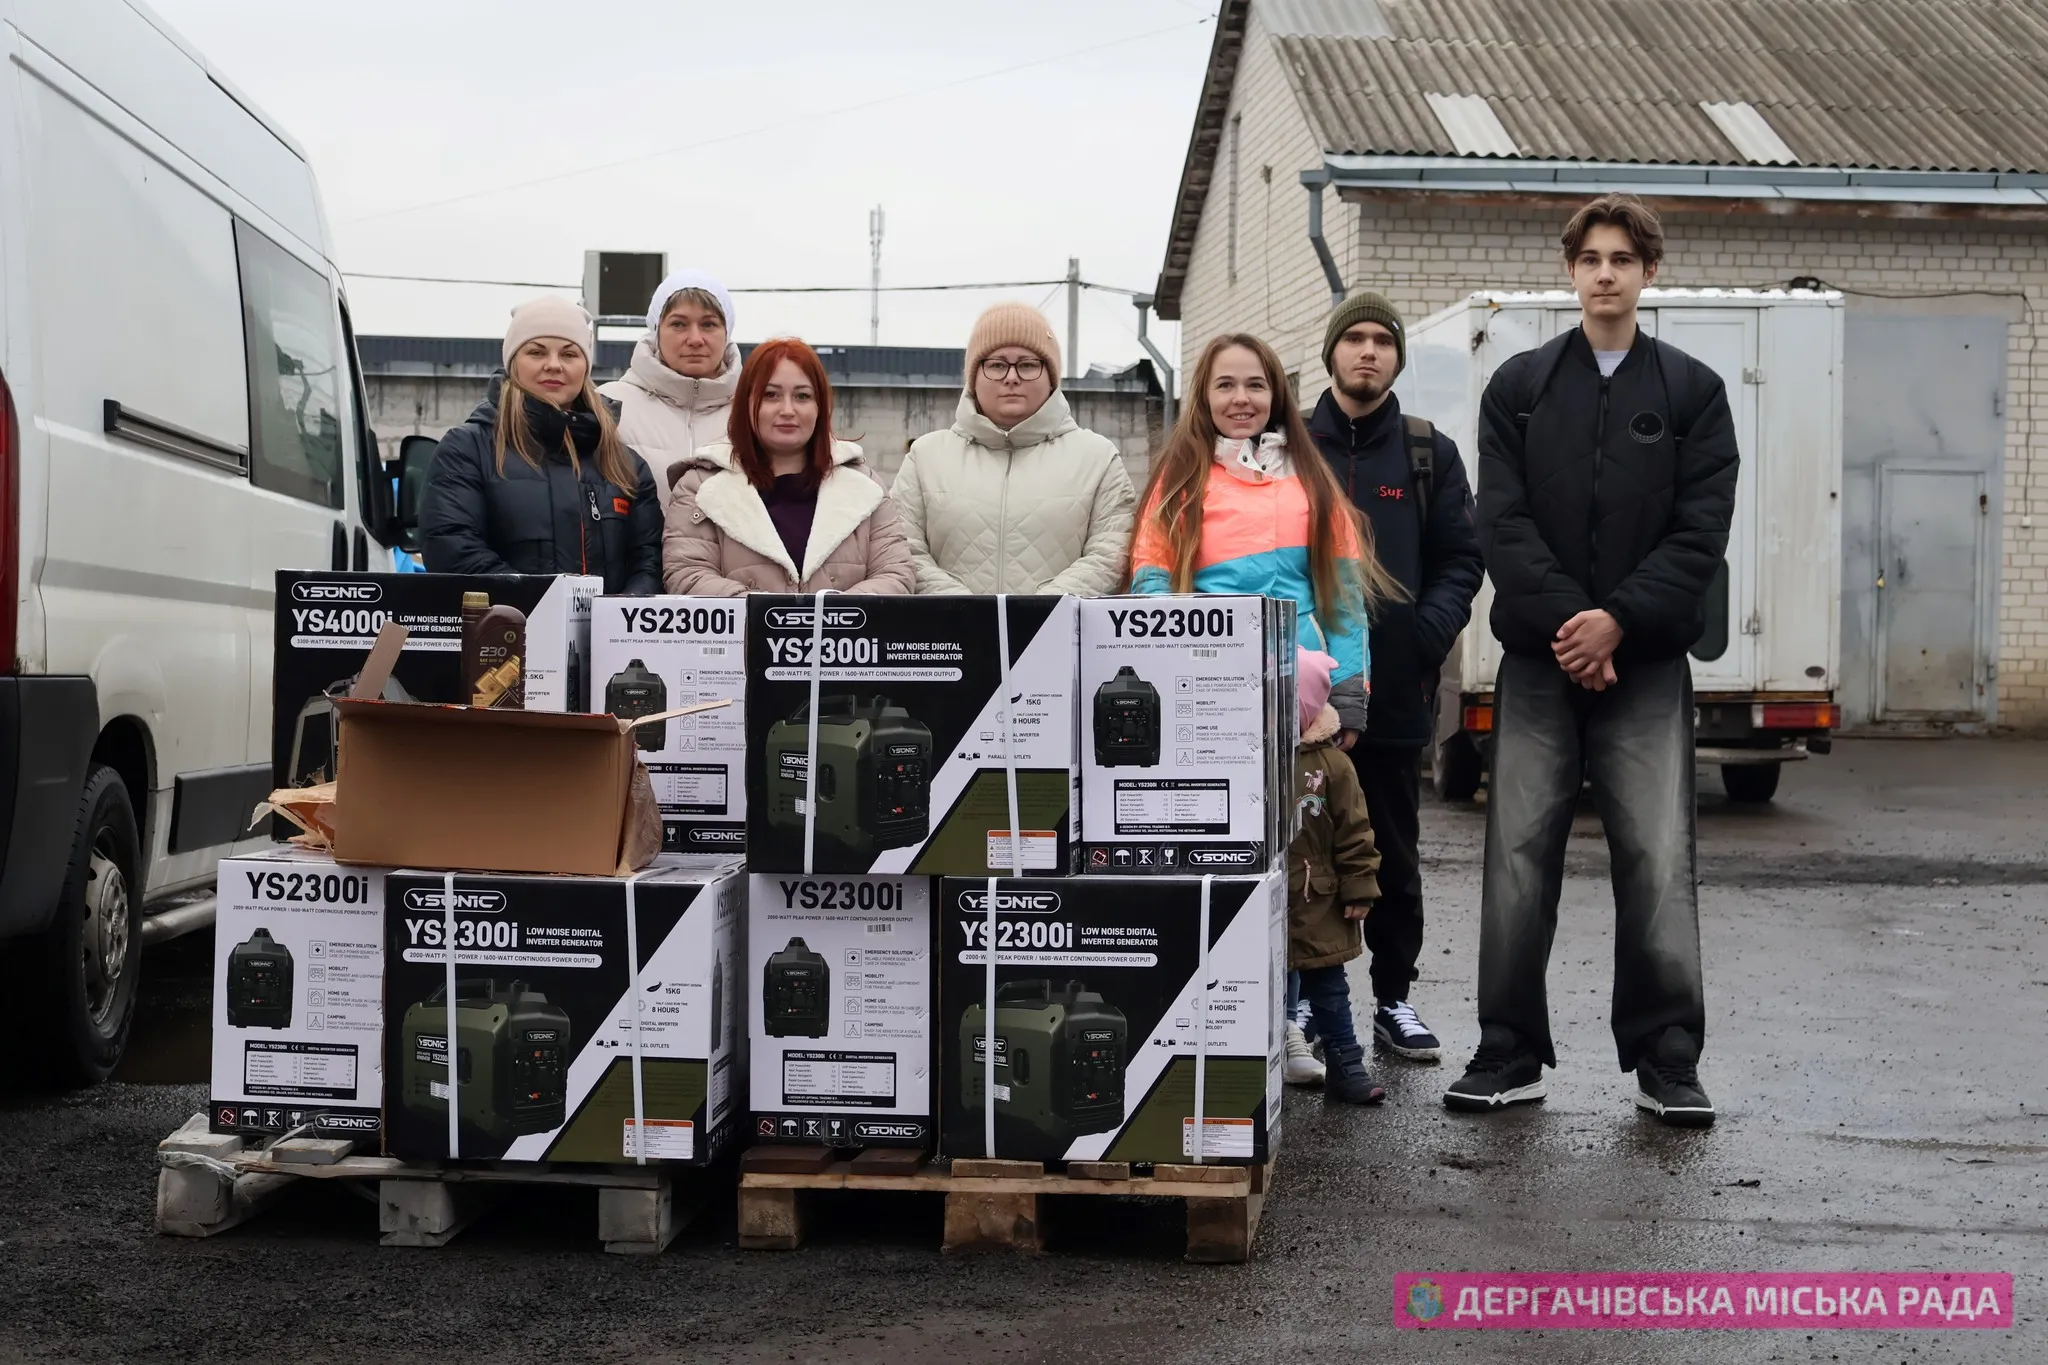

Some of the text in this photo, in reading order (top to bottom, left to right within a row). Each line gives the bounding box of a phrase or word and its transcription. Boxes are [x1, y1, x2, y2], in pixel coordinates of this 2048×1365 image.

[298, 585, 376, 599] YSONIC
[292, 608, 393, 634] YS4000i
[399, 615, 463, 624] LOW NOISE DIGITA
[621, 607, 734, 634] YS2300i
[772, 612, 859, 625] YSONIC
[1108, 608, 1233, 638] YS2300i
[480, 646, 507, 657] 230
[887, 642, 962, 651] LOW NOISE DIGITAL
[887, 653, 963, 661] INVERTER GENERATOR
[693, 831, 745, 840] YSONIC
[1193, 853, 1251, 862] YSONIC
[246, 871, 368, 904] YS2300i
[779, 881, 902, 911] YS2300i
[965, 895, 1053, 909] YSONIC
[527, 927, 602, 938] LOW NOISE DIGITAL
[1082, 927, 1157, 936] LOW NOISE DIGITAL
[526, 938, 603, 947] INVERTER GENERATOR
[1082, 938, 1158, 946] INVERTER GENERATOR
[418, 1038, 447, 1048] YSONIC
[320, 1116, 378, 1128] YSONIC
[860, 1125, 917, 1136] YSONIC
